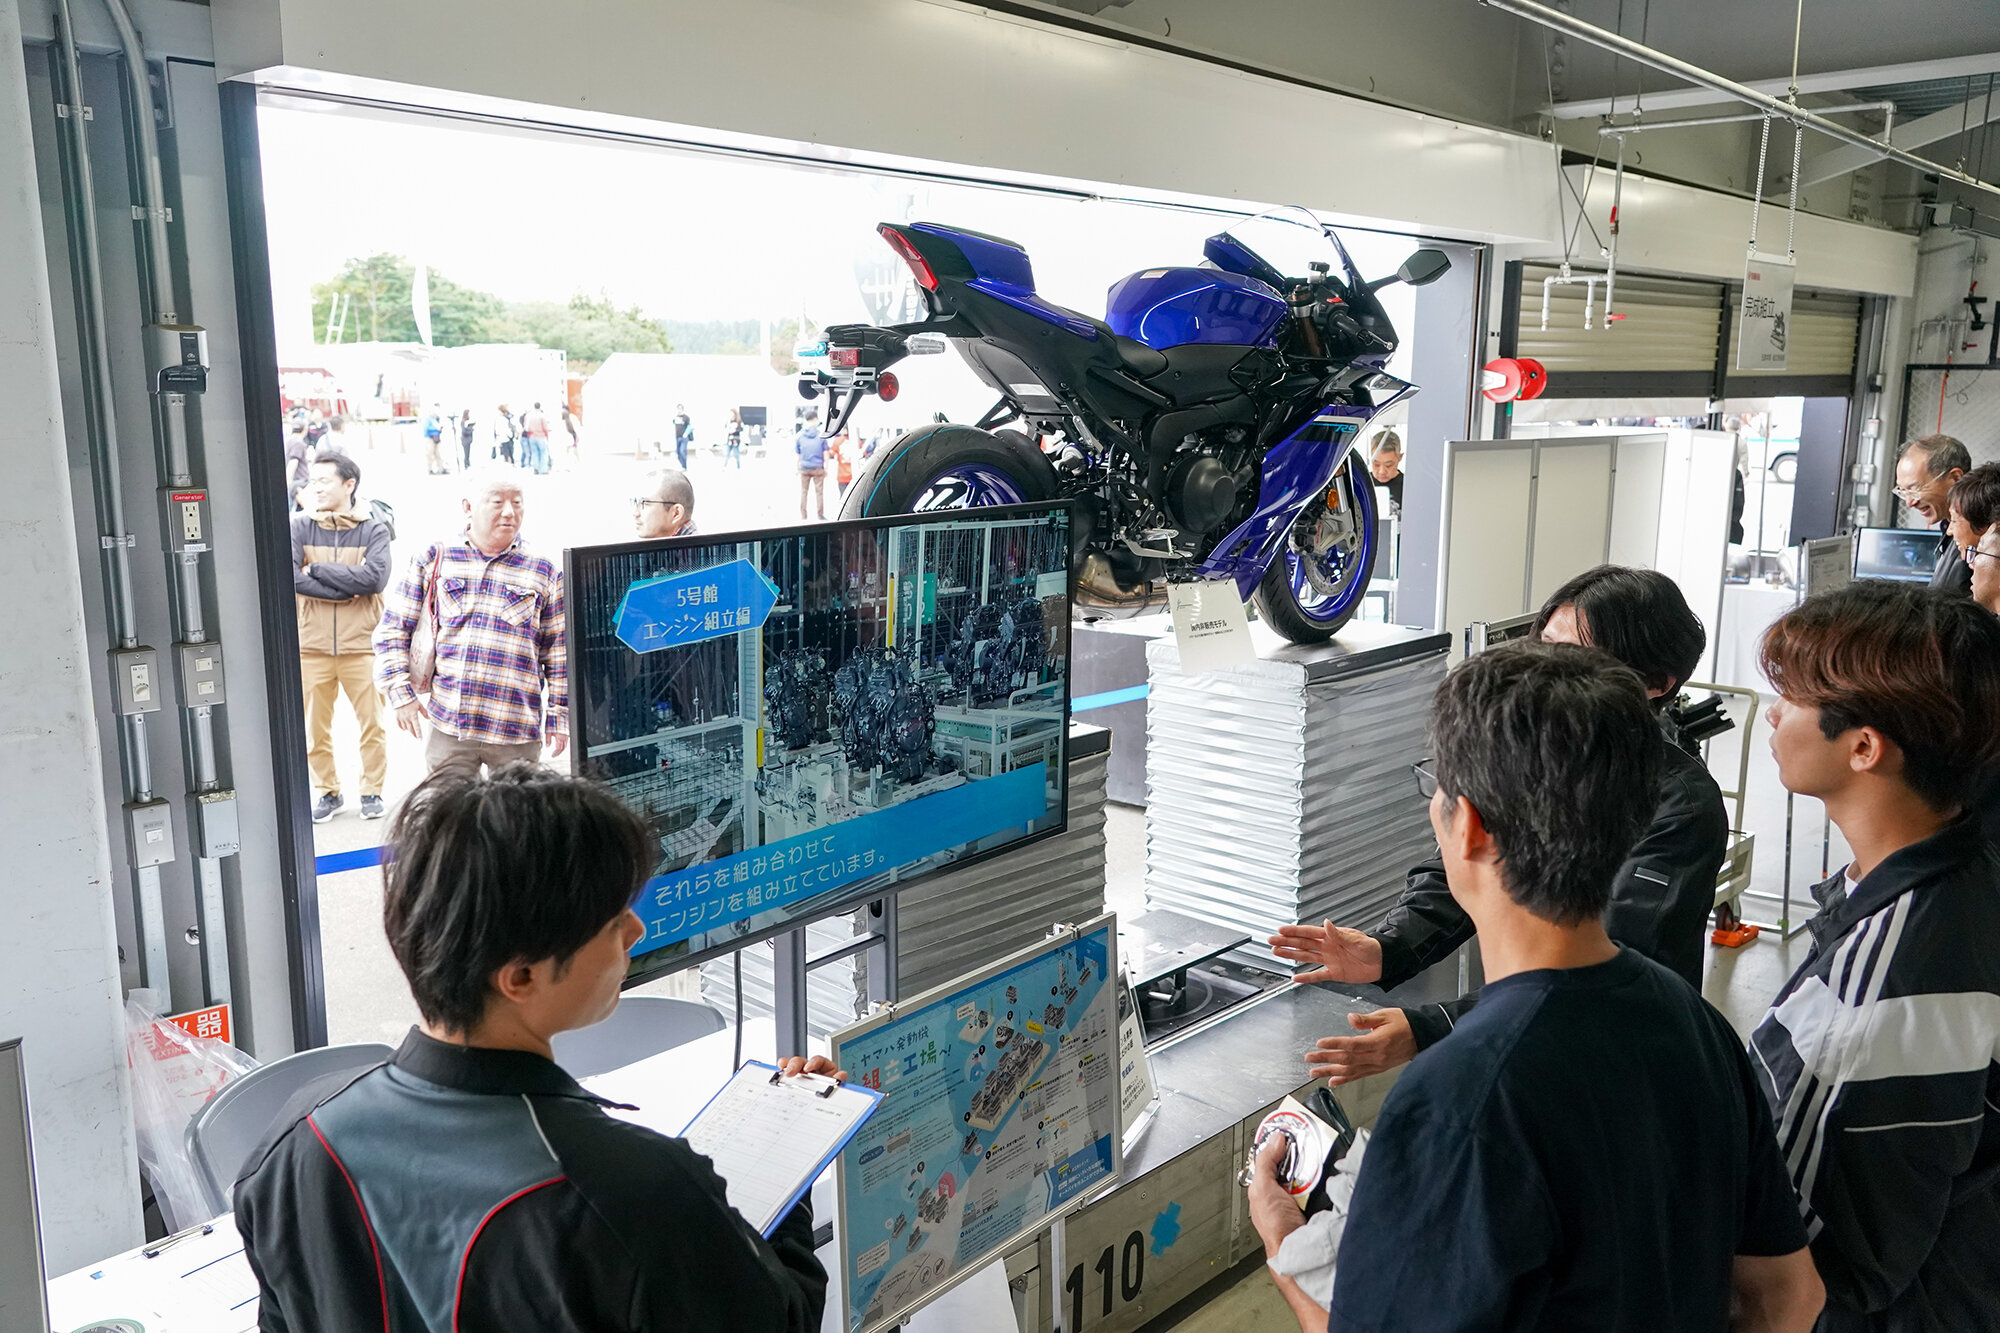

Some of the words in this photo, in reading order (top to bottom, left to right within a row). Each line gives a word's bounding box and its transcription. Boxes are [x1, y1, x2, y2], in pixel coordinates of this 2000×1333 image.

[1744, 296, 1775, 318] 完成組立
[1335, 424, 1358, 433] R9
[677, 583, 719, 607] 5号館
[643, 606, 751, 640] エンジン組立編
[654, 835, 837, 907] それらを組み合わせて
[639, 848, 886, 944] エンジンを組み立てています。
[860, 1025, 929, 1067] ヤマハ発動機
[1065, 1230, 1145, 1333] 110
